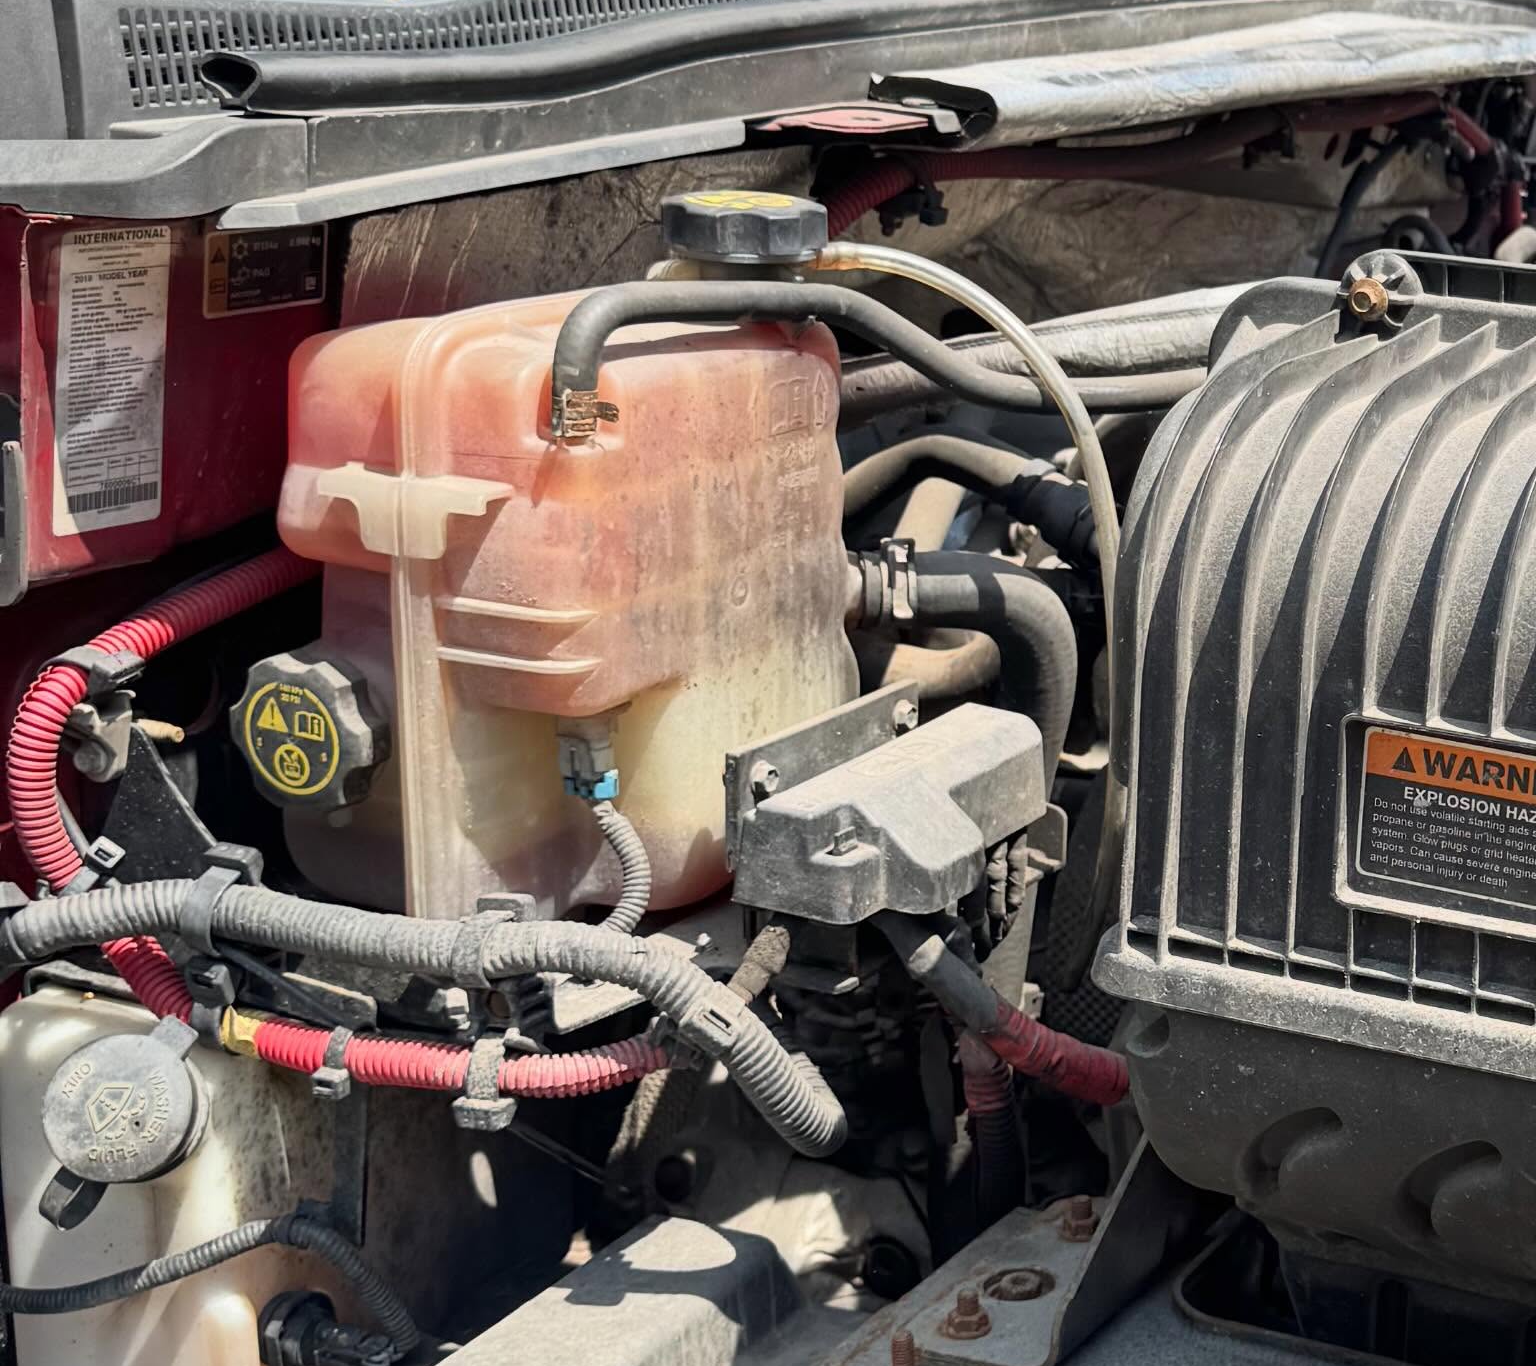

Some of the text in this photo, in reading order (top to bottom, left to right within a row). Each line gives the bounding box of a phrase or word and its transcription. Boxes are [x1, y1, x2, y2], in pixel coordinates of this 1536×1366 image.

[73, 227, 166, 245] INTERNATIONAL
[1374, 797, 1388, 809] Do
[1391, 802, 1406, 812] not
[1410, 806, 1427, 816] use
[1430, 810, 1465, 824] volatile
[1468, 817, 1505, 833] starting
[1508, 825, 1530, 836] aids
[1404, 786, 1500, 817] EXPLOSION
[1373, 813, 1413, 827] propane
[1416, 821, 1426, 829] or
[1429, 823, 1471, 838] gasoline
[1474, 831, 1484, 840] in
[1486, 833, 1502, 844] the
[1413, 833, 1439, 846] Glow
[1441, 840, 1469, 853] plugs
[1471, 846, 1481, 854] or
[1484, 848, 1503, 859] grid
[1370, 853, 1389, 864] and
[1391, 857, 1434, 873] personal
[1436, 864, 1464, 881] injury
[1466, 873, 1477, 881] or
[1410, 846, 1431, 858] Can
[1433, 852, 1464, 865] cause
[1466, 859, 1500, 873] severe
[1503, 865, 1536, 879] engine
[61, 1062, 92, 1099] ONLY
[140, 1069, 171, 1143] WASHER
[88, 1143, 138, 1163] FLUID
